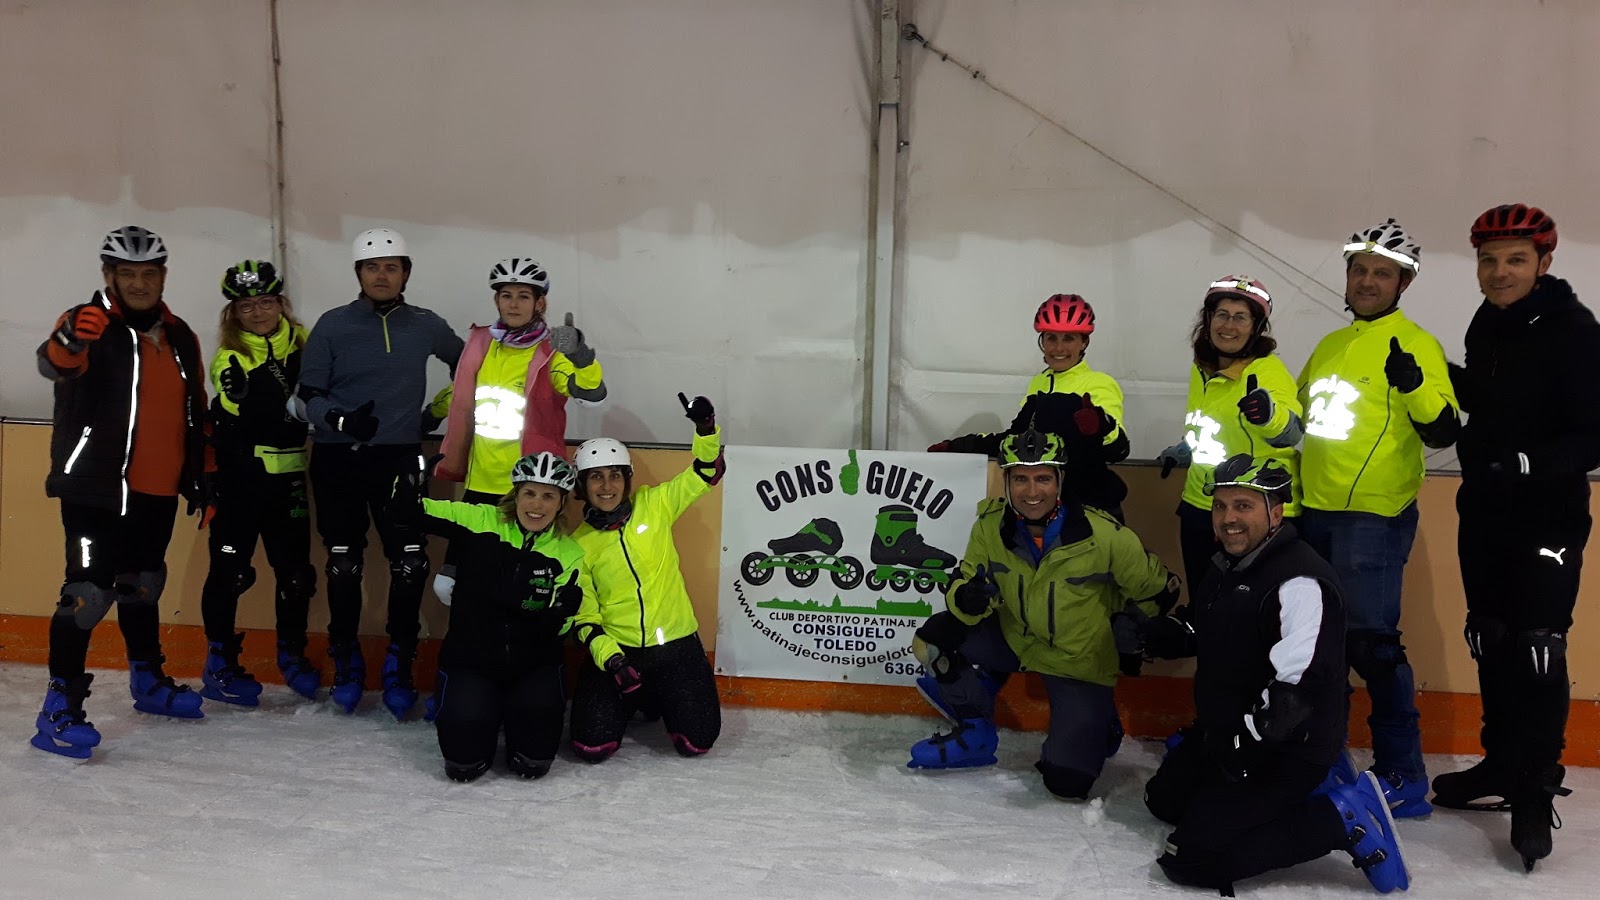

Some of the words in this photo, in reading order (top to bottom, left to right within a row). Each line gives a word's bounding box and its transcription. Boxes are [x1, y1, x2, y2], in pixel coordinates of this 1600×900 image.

[756, 459, 834, 512] CONS
[866, 460, 954, 520] GUELO
[769, 611, 795, 622] CLUB
[797, 613, 861, 625] DEPORTIVO
[863, 617, 917, 629] PATINAJE
[792, 622, 896, 640] CONSIGUELO
[813, 638, 877, 652] TOLEDO
